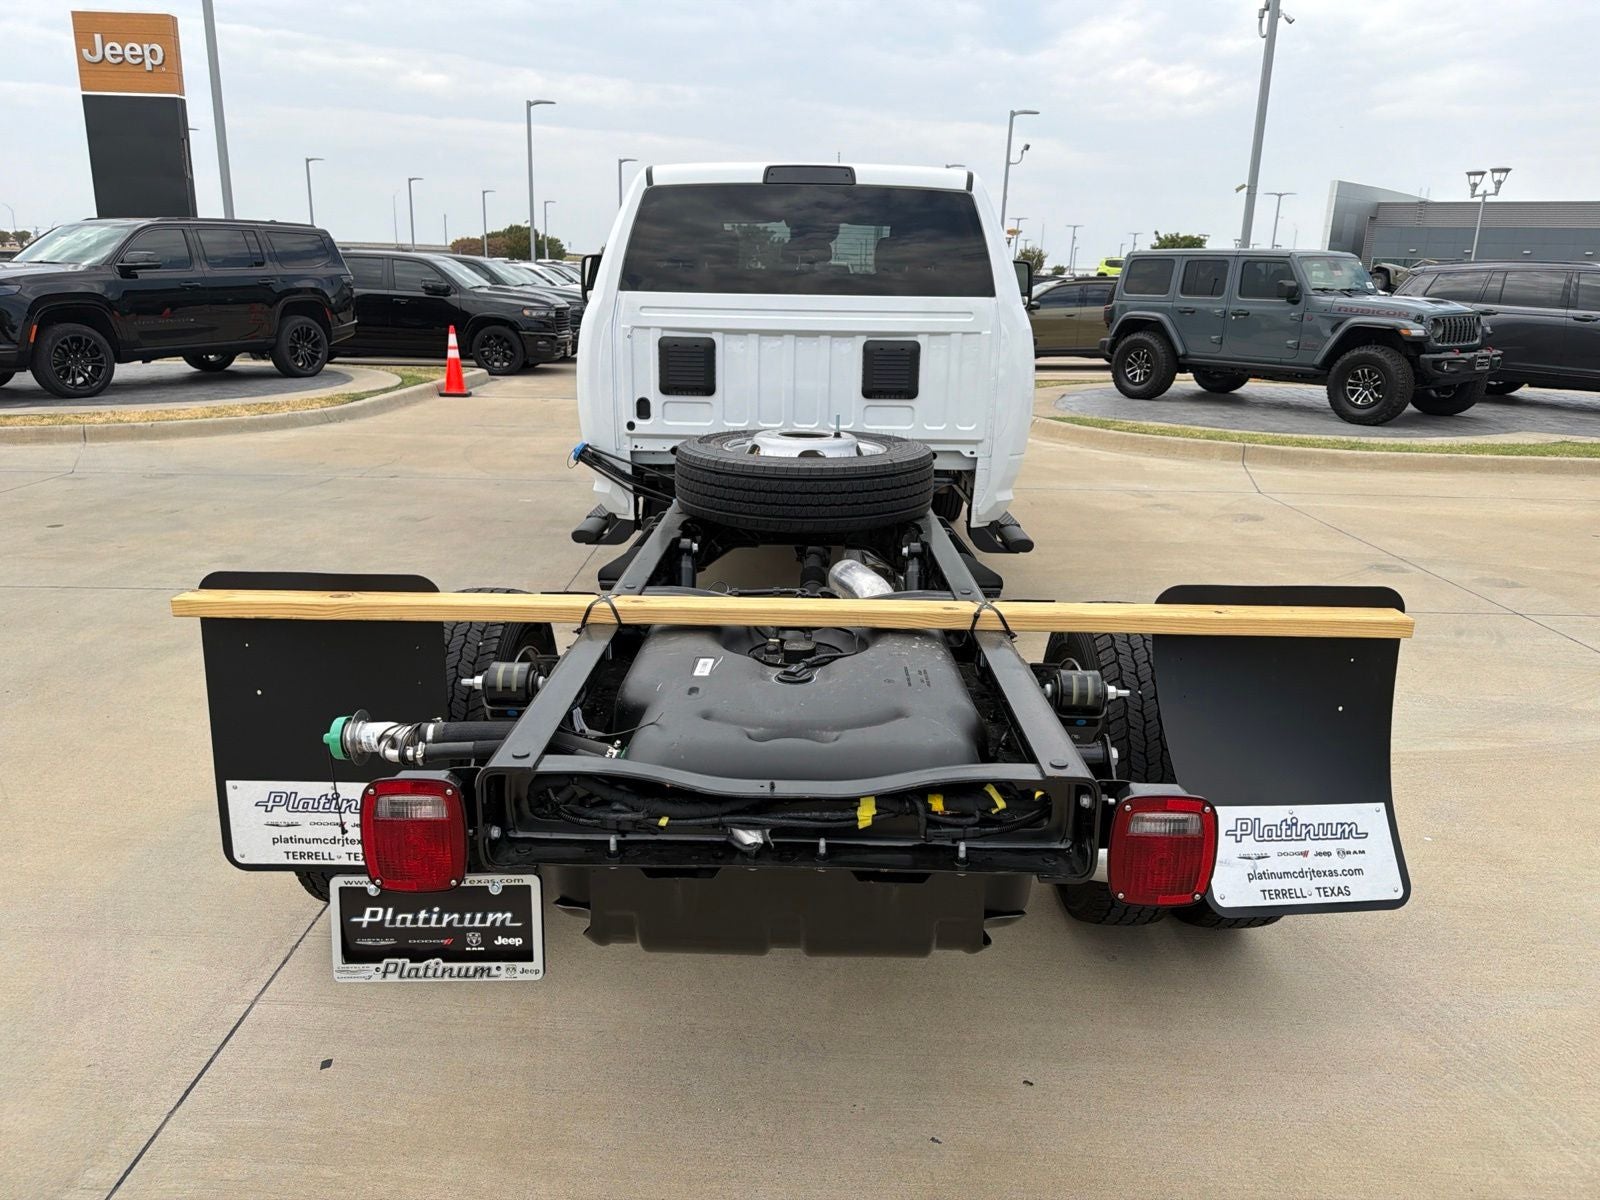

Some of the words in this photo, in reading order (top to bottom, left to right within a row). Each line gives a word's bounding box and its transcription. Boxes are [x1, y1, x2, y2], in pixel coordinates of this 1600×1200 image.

[82, 33, 164, 71] Jeep
[1338, 306, 1409, 317] RUBICON
[255, 791, 361, 814] Platin
[1225, 816, 1368, 843] Platinum
[284, 851, 335, 861] TERRELL
[1314, 850, 1332, 858] Jeep
[1247, 867, 1364, 884] platinumcdrjtexas.com
[1260, 888, 1307, 901] TERRELL
[1315, 885, 1351, 898] TEXAS
[350, 907, 523, 928] Platinum
[494, 936, 523, 946] Jeep
[382, 961, 499, 979] Platinum
[519, 967, 540, 975] Jeep
